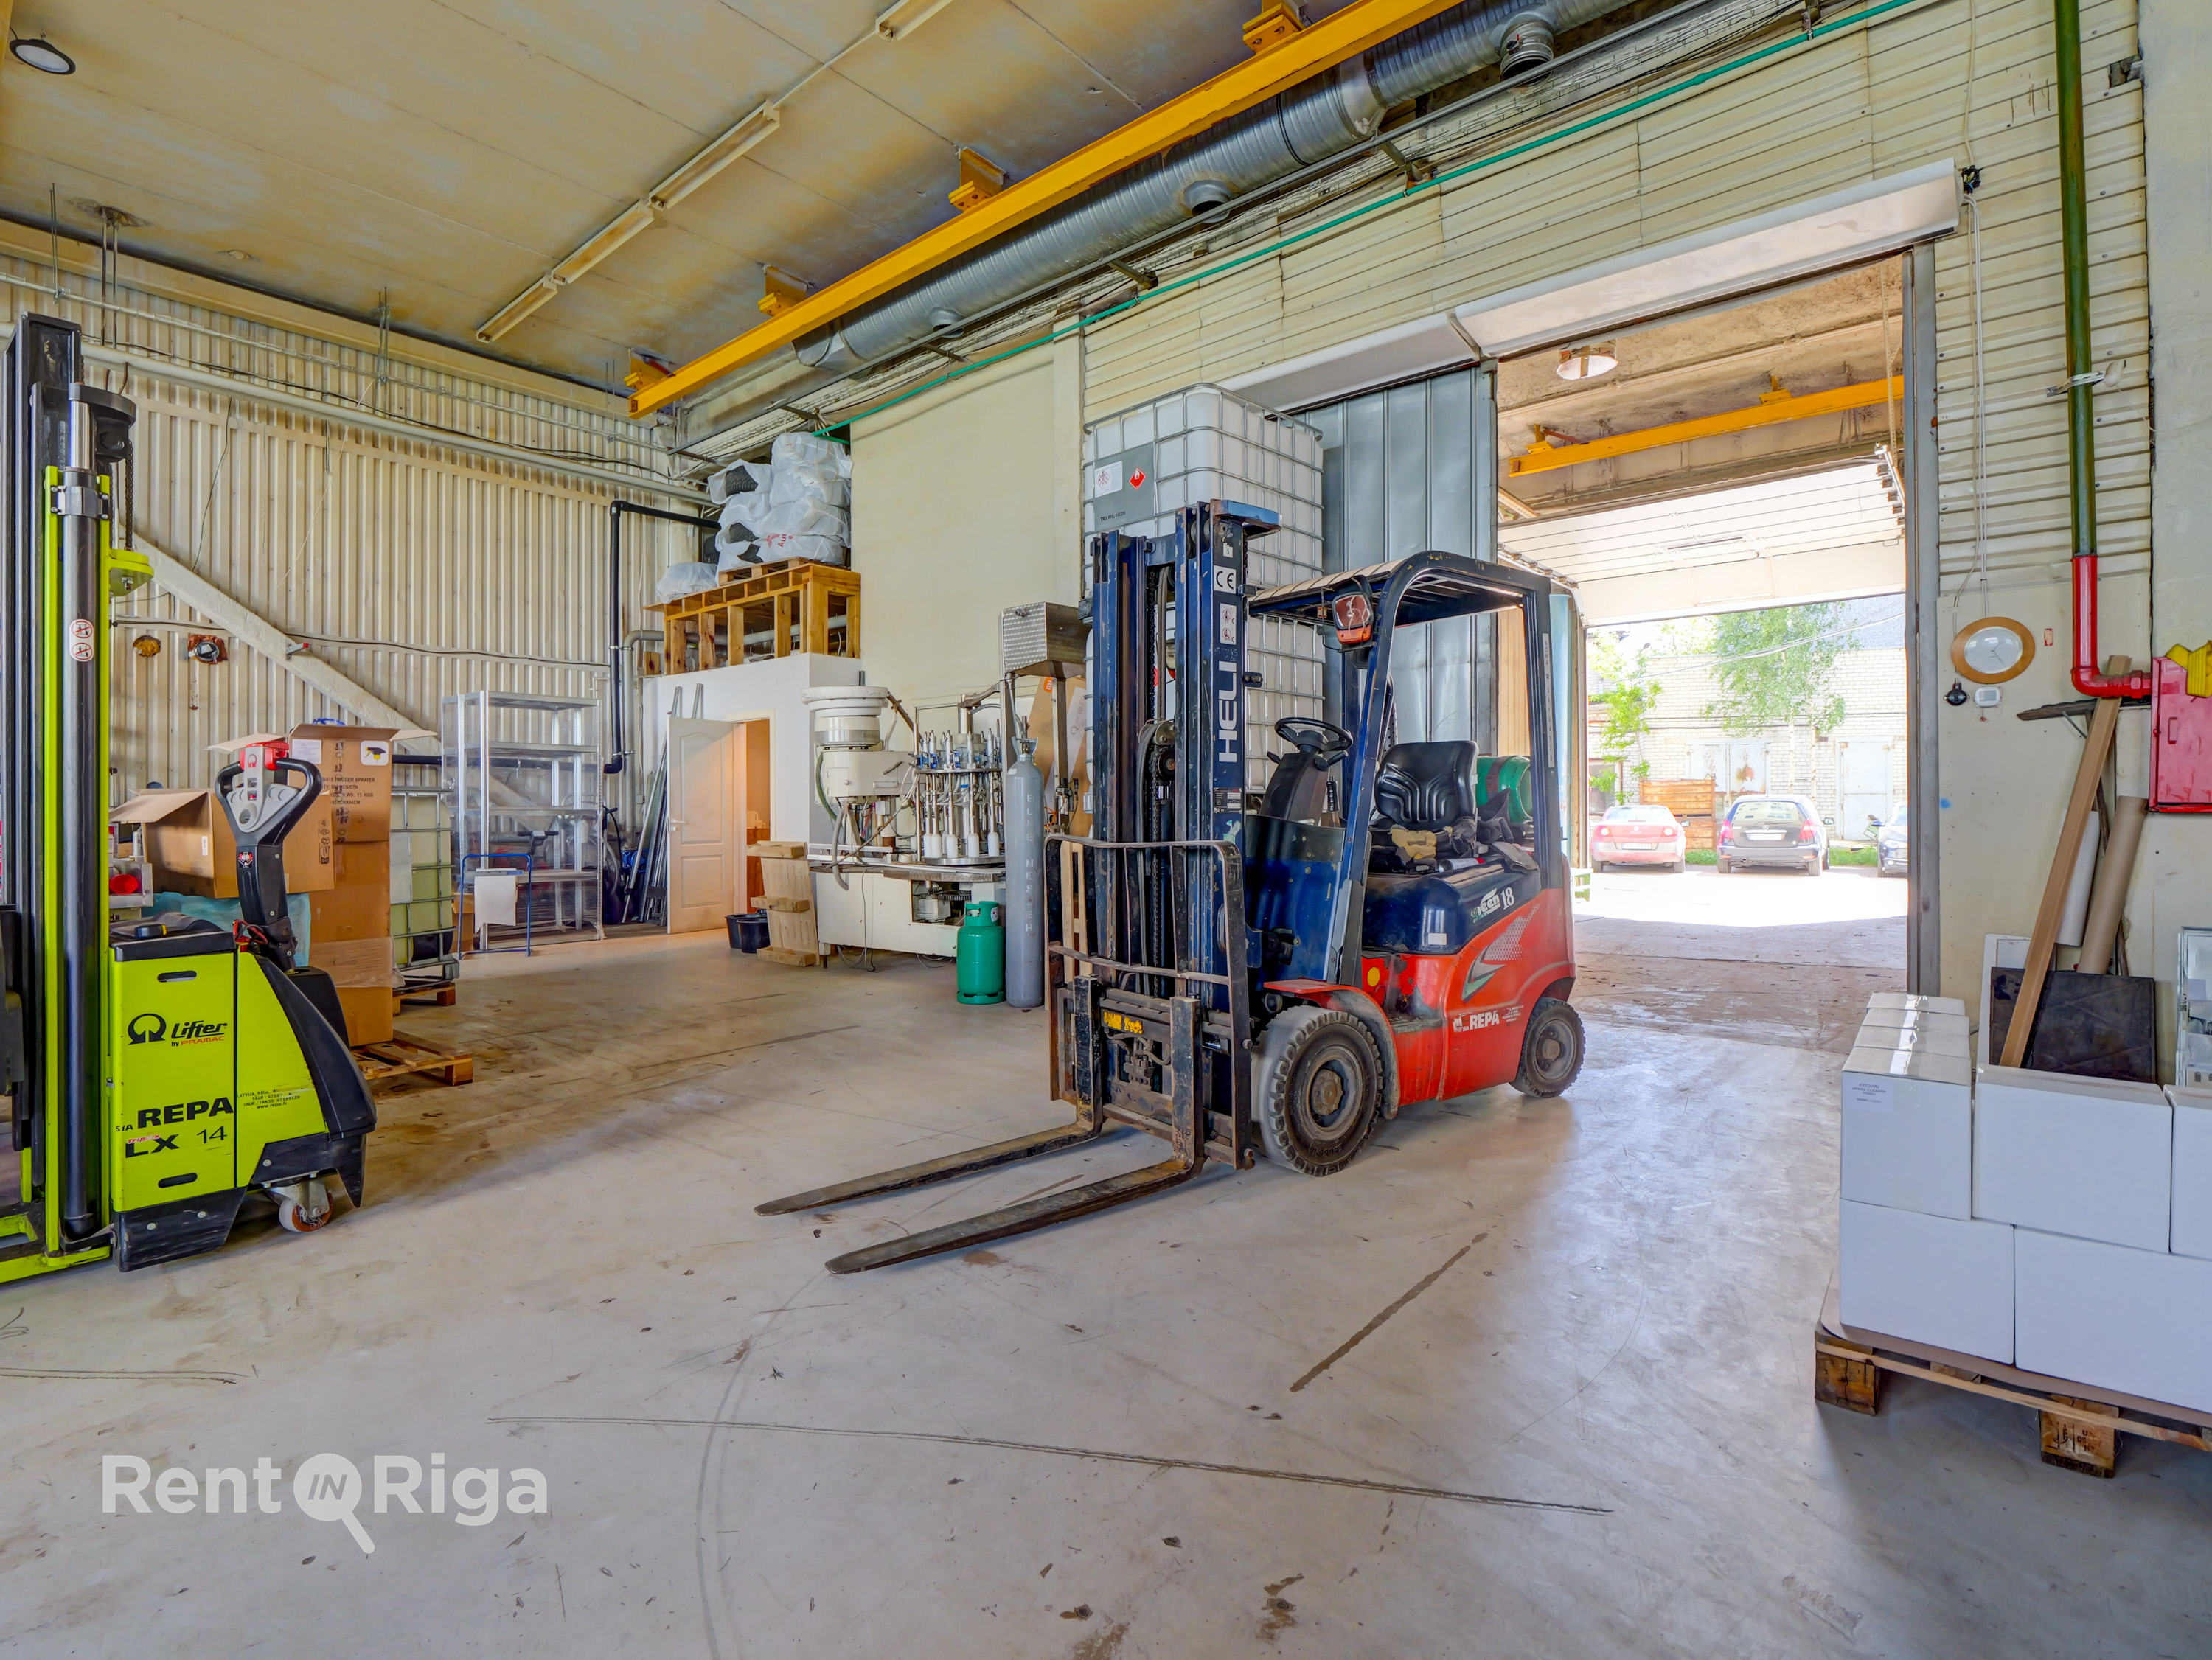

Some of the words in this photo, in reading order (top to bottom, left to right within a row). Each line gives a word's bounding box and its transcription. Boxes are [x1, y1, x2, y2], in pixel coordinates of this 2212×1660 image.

[1216, 571, 1234, 590] CE
[1218, 660, 1237, 763] HELI
[1500, 887, 1514, 910] 18
[171, 1020, 228, 1039] Lifter
[1470, 1011, 1500, 1030] REPA
[181, 1035, 225, 1045] PRAMAC
[137, 1097, 234, 1129] REPA
[125, 1134, 180, 1158] LX
[197, 1126, 227, 1144] 14
